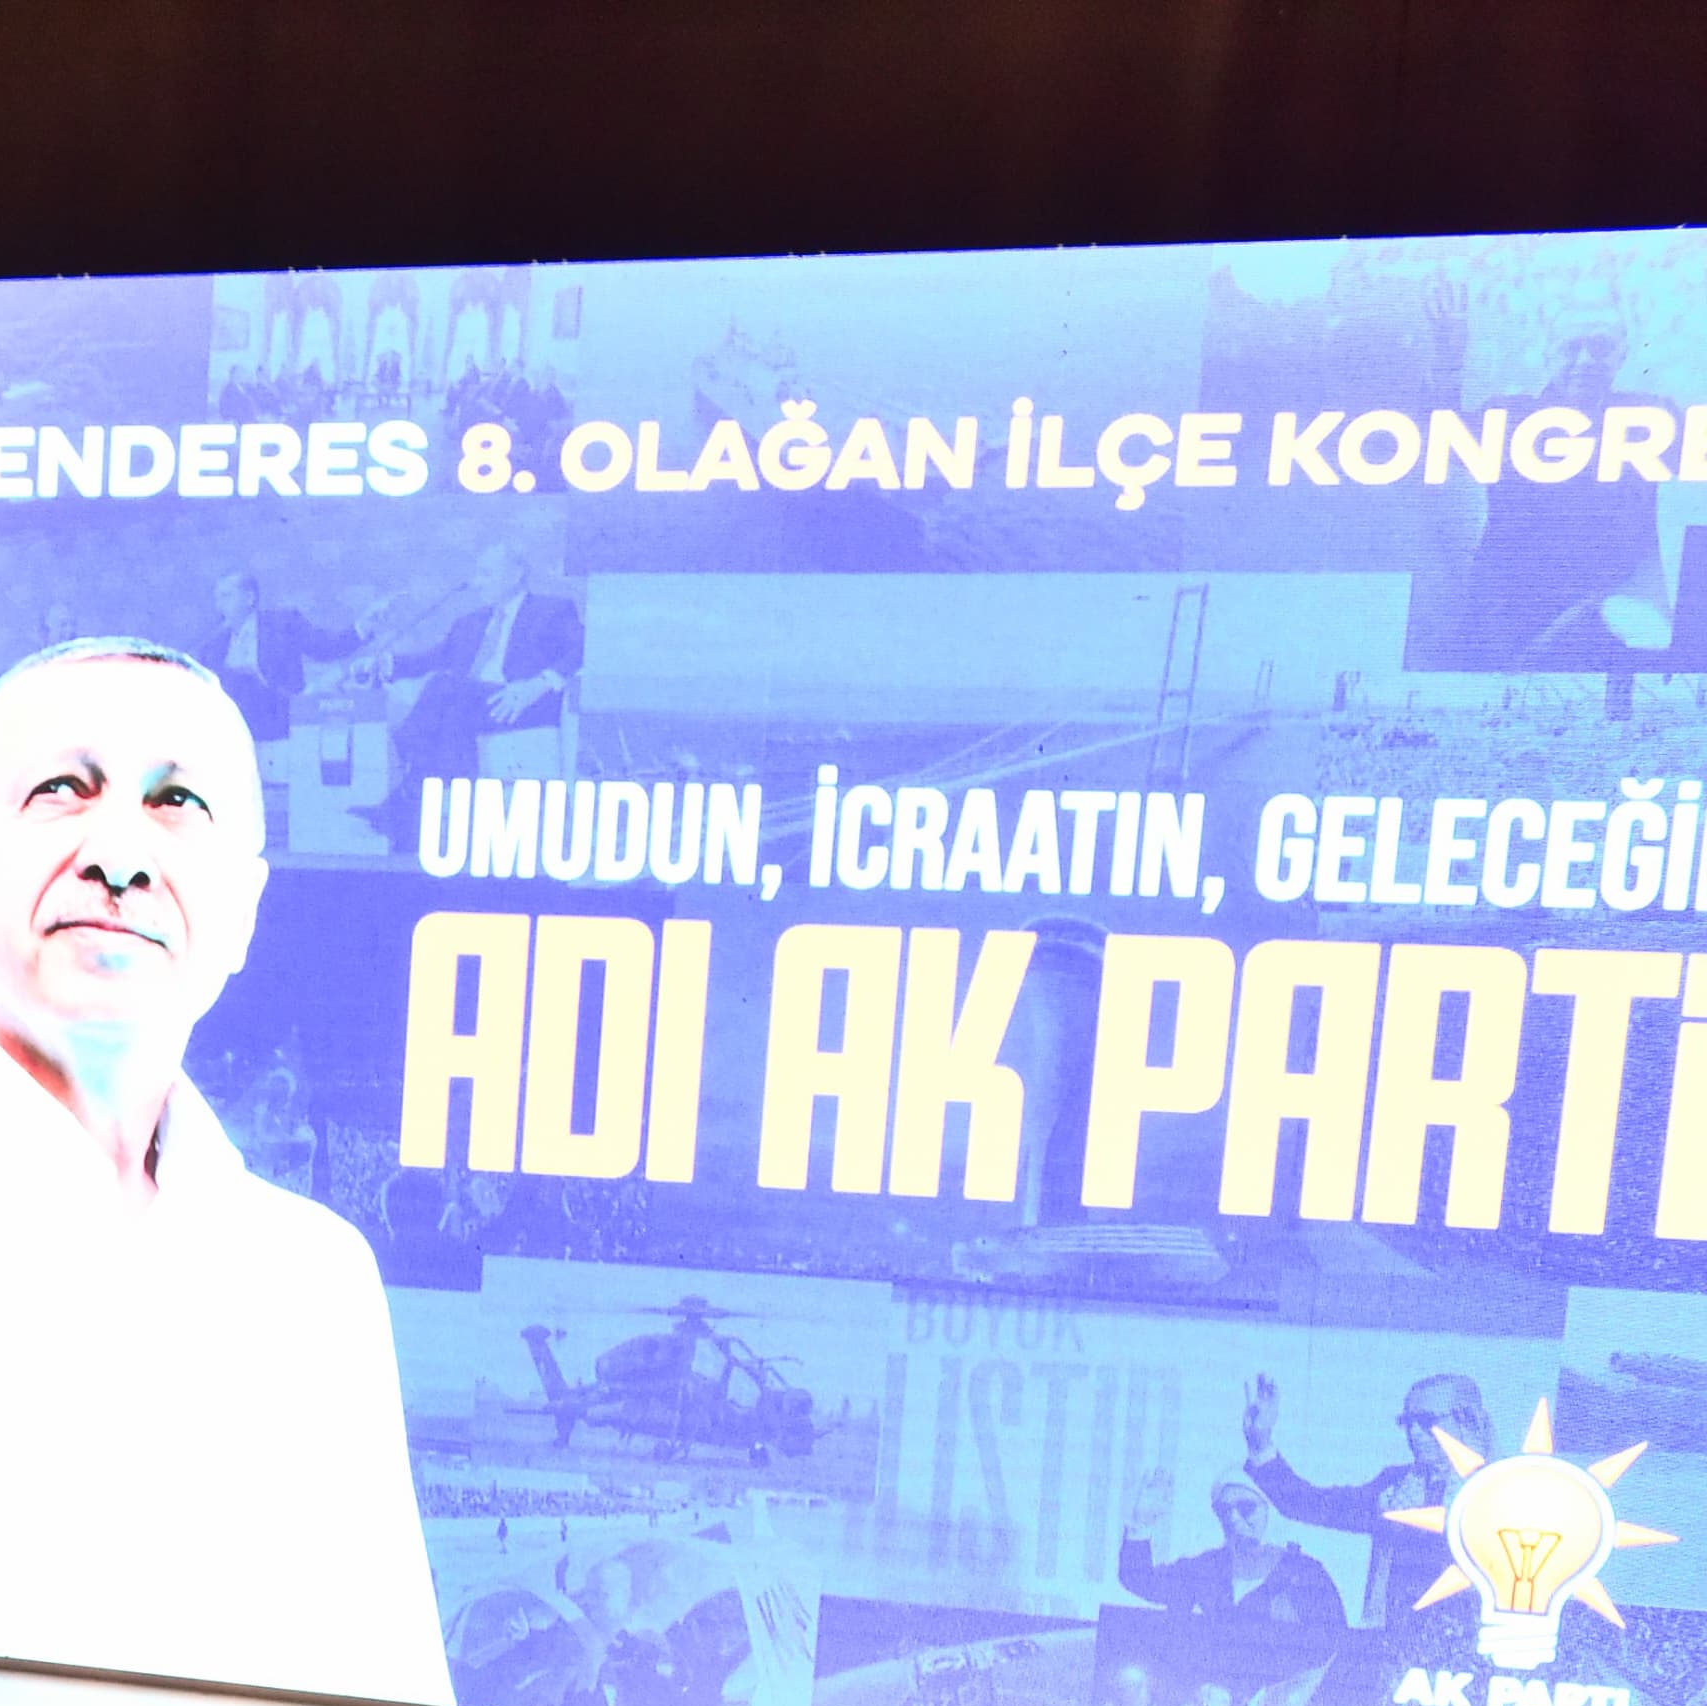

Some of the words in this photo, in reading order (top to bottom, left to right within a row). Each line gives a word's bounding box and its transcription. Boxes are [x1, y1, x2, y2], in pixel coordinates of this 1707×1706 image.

[456, 422, 537, 496] 8.
[559, 398, 978, 494] OLAĞAN
[1005, 396, 1242, 511] İLÇE
[419, 776, 783, 901] UMUDUN,
[809, 764, 1225, 914] İCRAATIN,
[1254, 777, 1707, 912] GELECEĞİ
[398, 910, 712, 1184] ADI
[757, 924, 1037, 1202] AK
